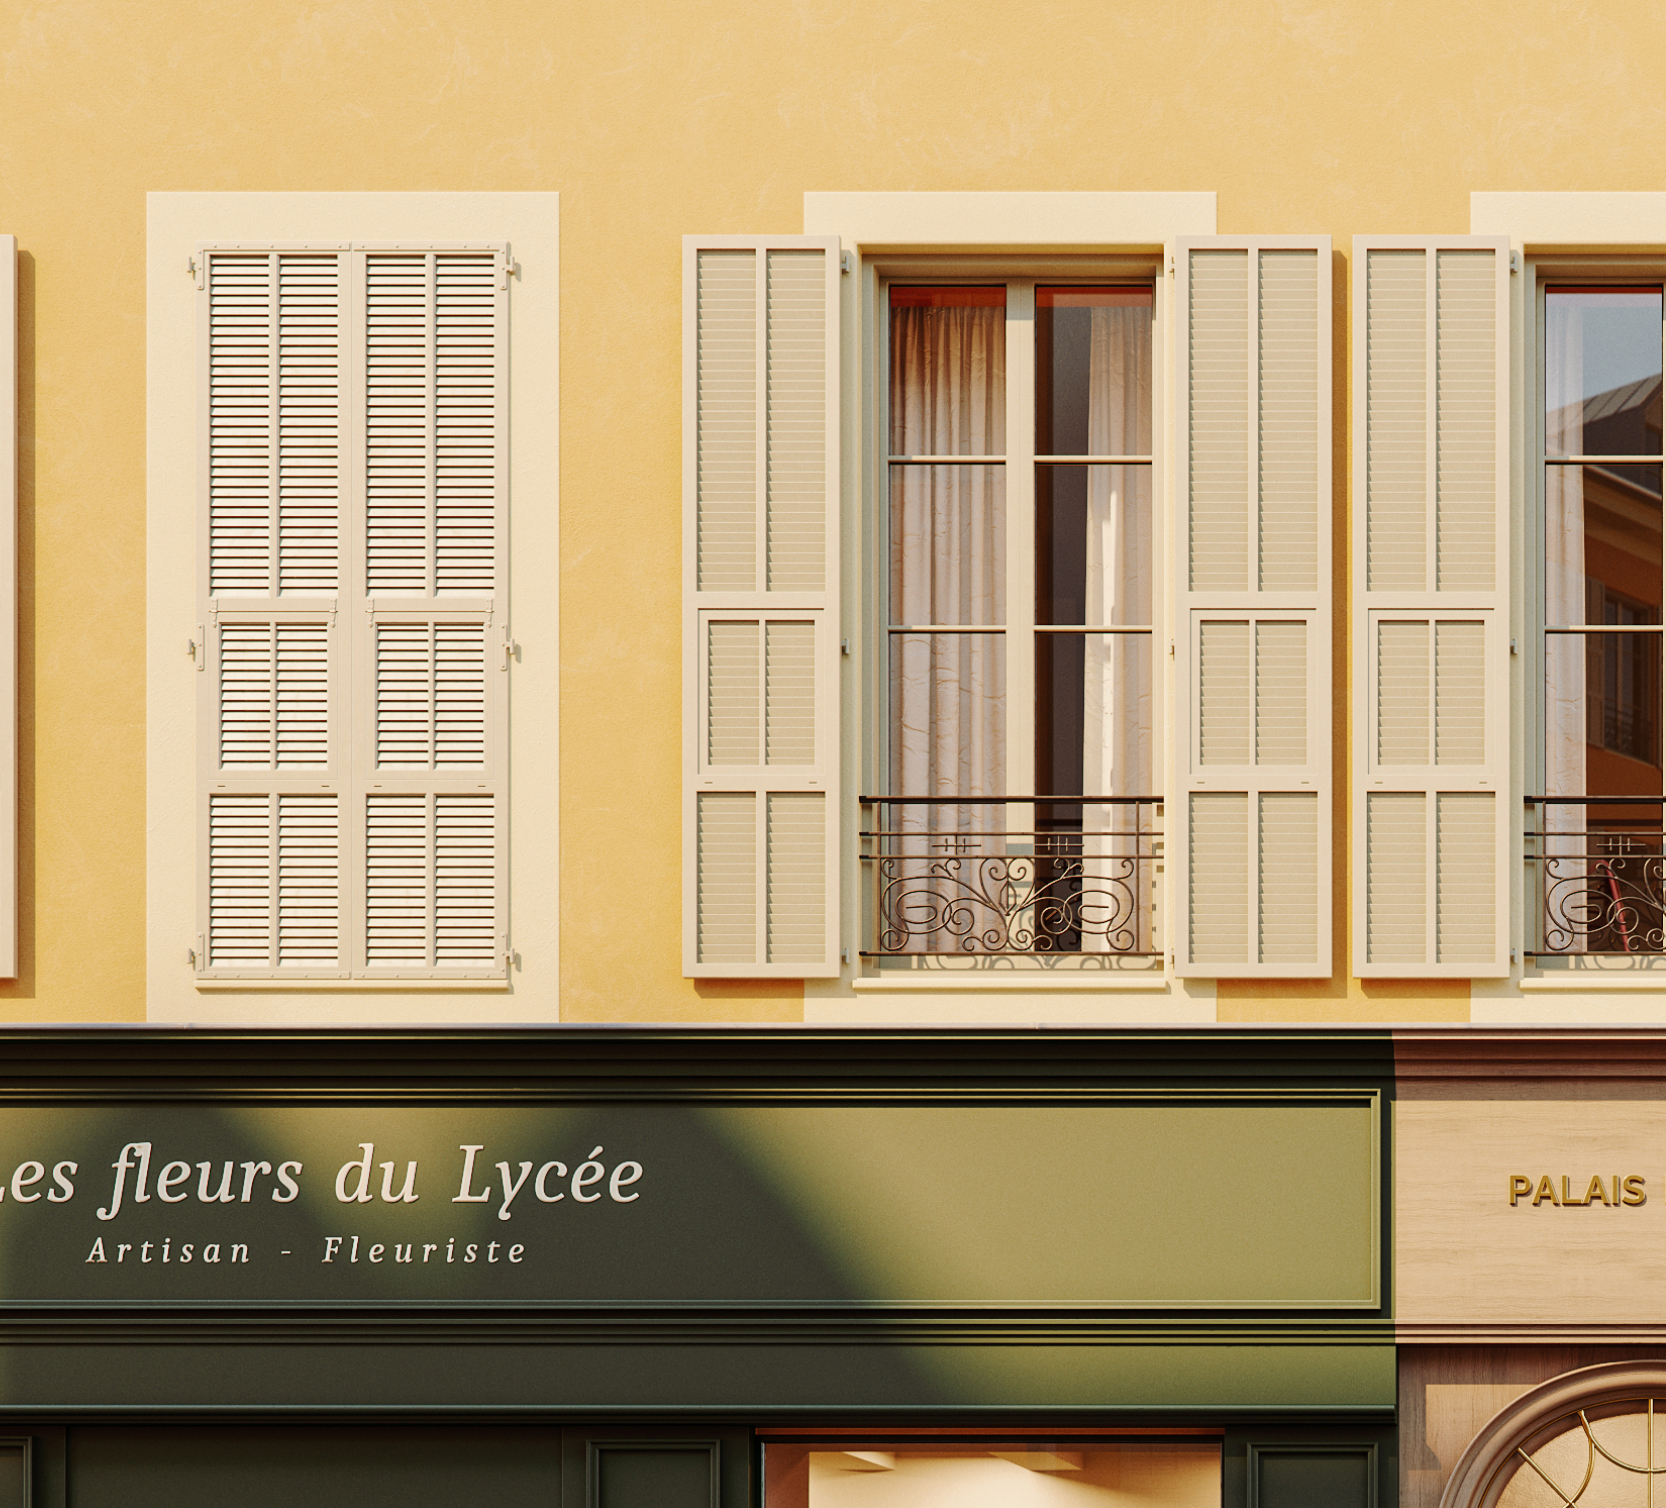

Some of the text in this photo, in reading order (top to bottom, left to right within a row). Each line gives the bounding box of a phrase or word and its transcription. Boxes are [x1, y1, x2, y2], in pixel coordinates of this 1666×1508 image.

[0, 1142, 644, 1220] es fleurs du Lycée
[1509, 1175, 1646, 1206] PALAIS
[86, 1237, 251, 1263] Artisan
[322, 1236, 526, 1263] Fleuriste
